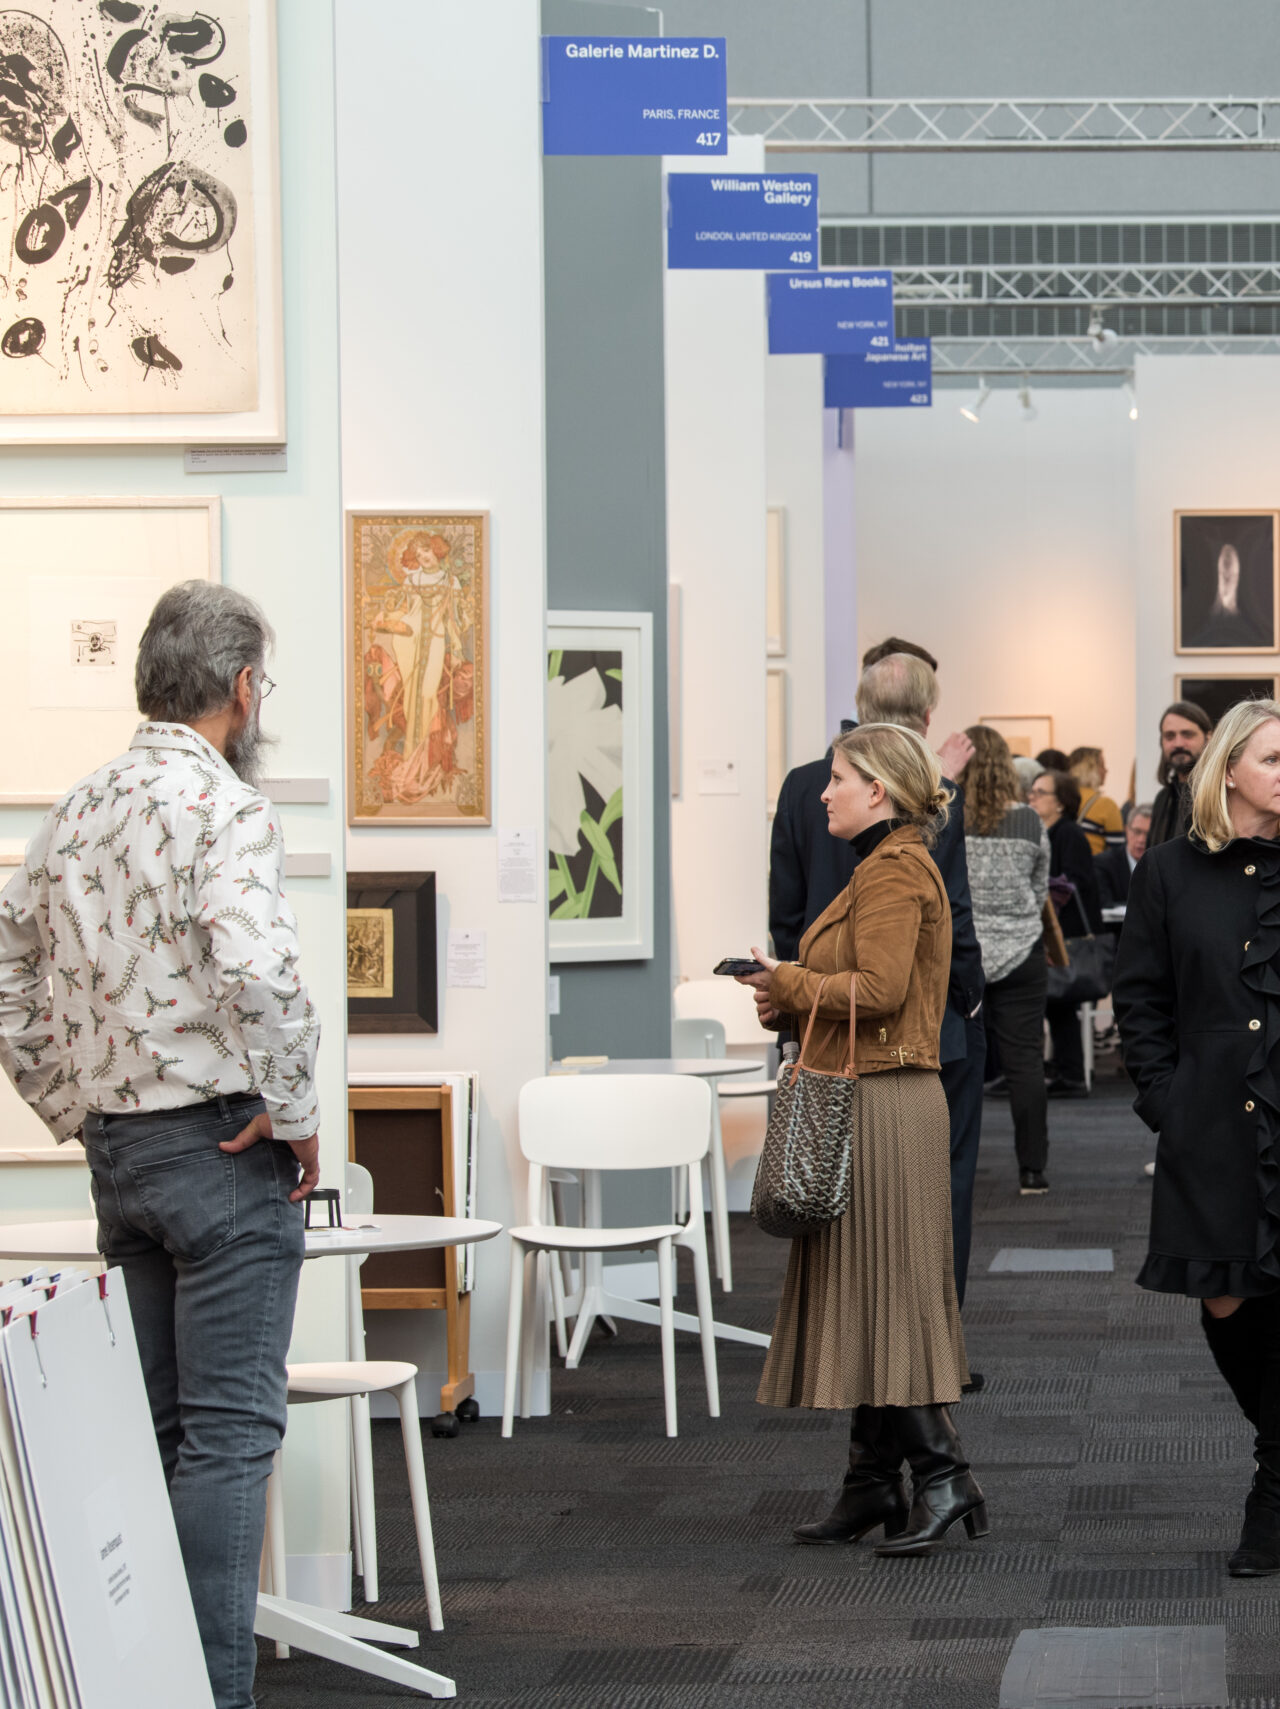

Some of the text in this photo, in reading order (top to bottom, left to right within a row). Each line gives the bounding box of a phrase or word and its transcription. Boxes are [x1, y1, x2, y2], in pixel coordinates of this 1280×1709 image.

[565, 43, 719, 59] Galerie Martinez D.
[642, 109, 720, 121] PARIS, FRANCE
[695, 132, 721, 146] 417
[711, 179, 812, 192] William Weston
[763, 192, 812, 207] Gallery
[695, 231, 812, 242] LONDON, UNITED KINGDOM
[789, 251, 813, 264] 419
[789, 276, 888, 289] Ursus Rare Books
